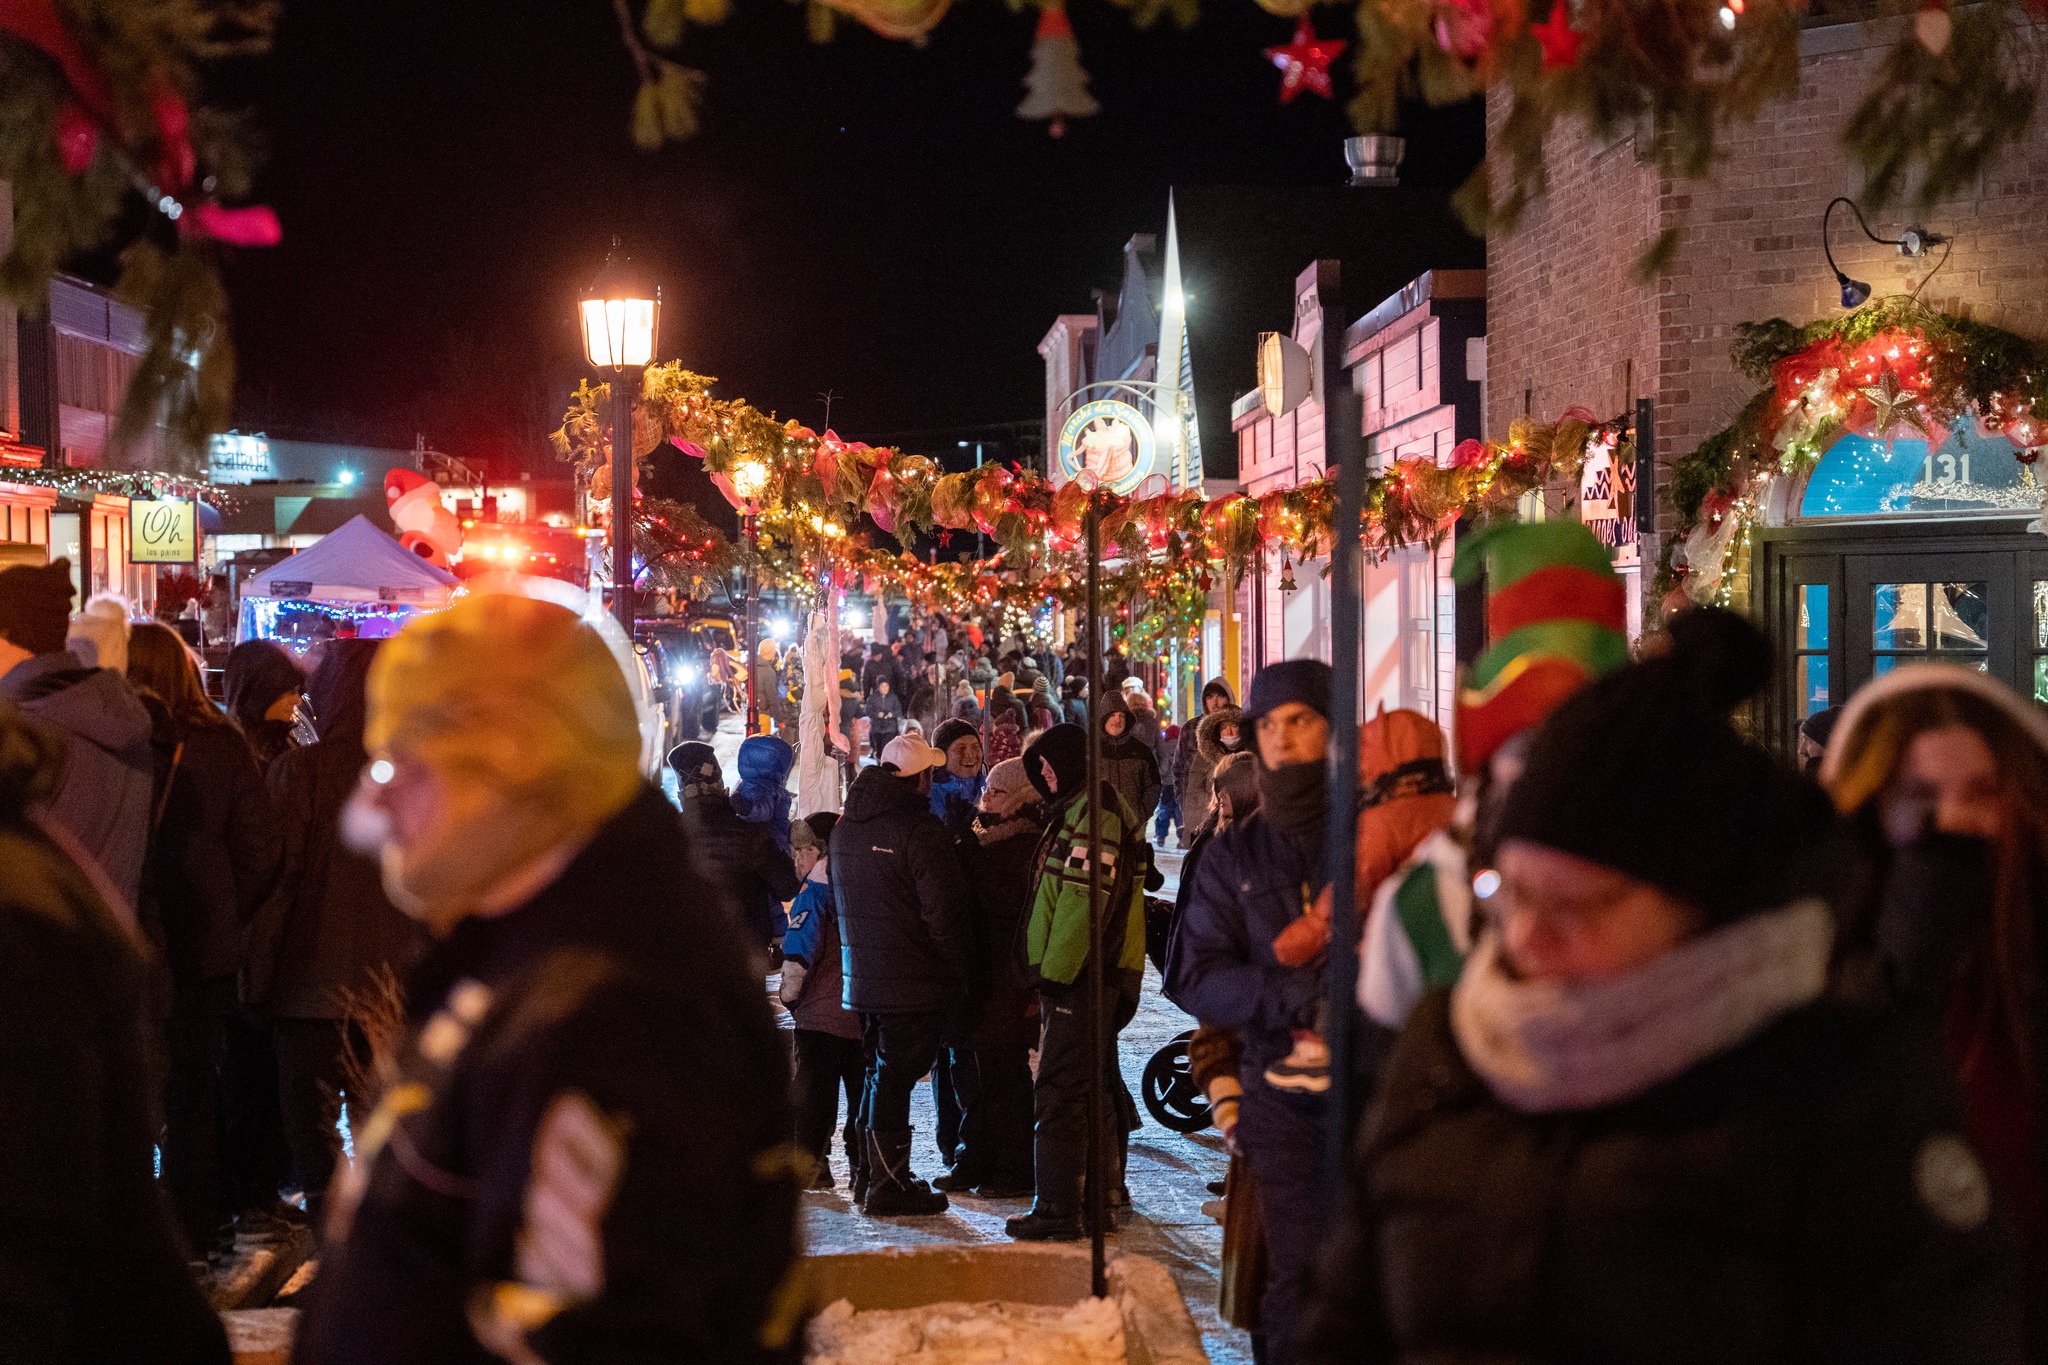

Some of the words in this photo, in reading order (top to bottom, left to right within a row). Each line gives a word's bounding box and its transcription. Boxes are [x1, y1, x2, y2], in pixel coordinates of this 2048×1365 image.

[1094, 401, 1113, 414] des
[1923, 453, 1970, 485] 131
[142, 505, 184, 544] Oh
